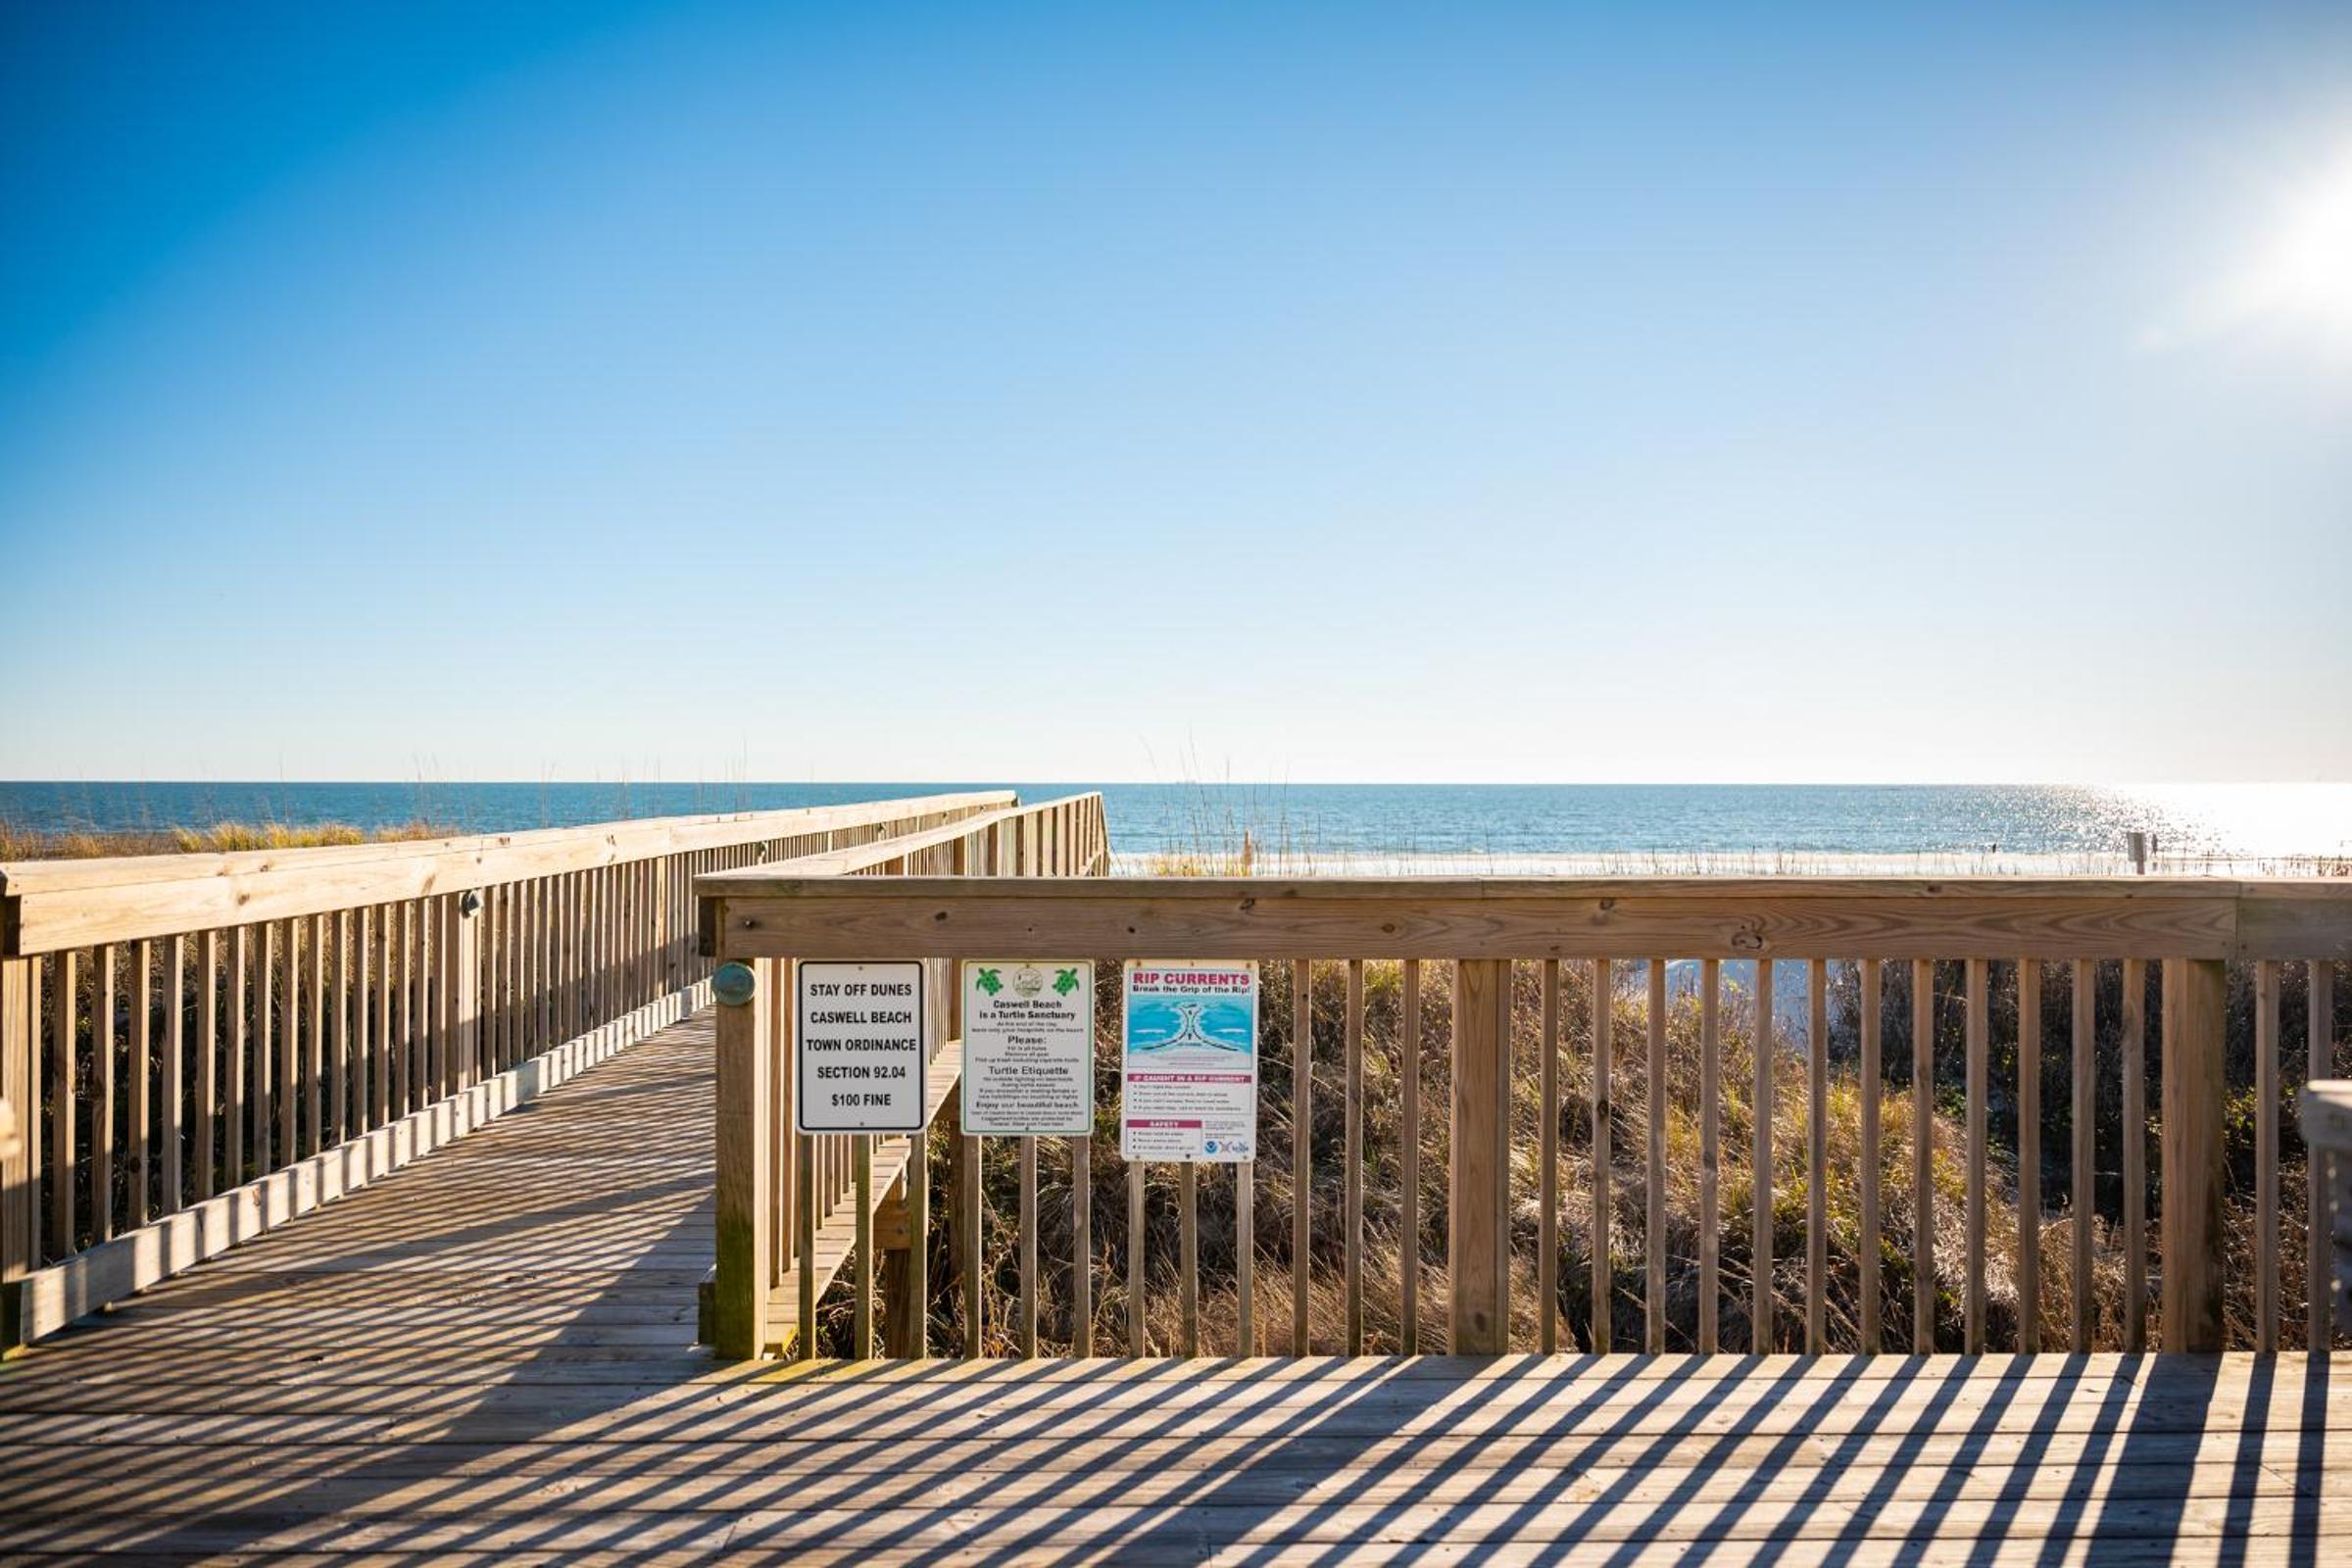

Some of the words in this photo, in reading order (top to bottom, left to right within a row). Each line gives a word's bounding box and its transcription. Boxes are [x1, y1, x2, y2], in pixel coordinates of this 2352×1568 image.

[1133, 973, 1159, 984] RIP
[1164, 973, 1250, 985] CURRENTS
[810, 984, 840, 996] STAY
[845, 984, 867, 996] OFF
[871, 984, 911, 996] DUNES
[1180, 986, 1200, 995] Grip
[1232, 986, 1250, 995] Rip!
[993, 1000, 1030, 1008] Caswell
[1033, 1000, 1062, 1008] Beach
[810, 1011, 867, 1023] CASWELL
[871, 1011, 911, 1023] BEACH
[999, 1010, 1026, 1019] Turtle
[1027, 1010, 1076, 1021] Sanctuary
[806, 1039, 842, 1051] TOWN
[845, 1039, 916, 1051] ORDINANCE
[1007, 1035, 1047, 1044] Please:
[817, 1066, 870, 1078] SECTION
[873, 1066, 906, 1078] 92.04
[989, 1066, 1018, 1075] Turtle
[1021, 1066, 1069, 1076] Etiquette
[831, 1093, 860, 1106] $100
[863, 1094, 891, 1105] FINE
